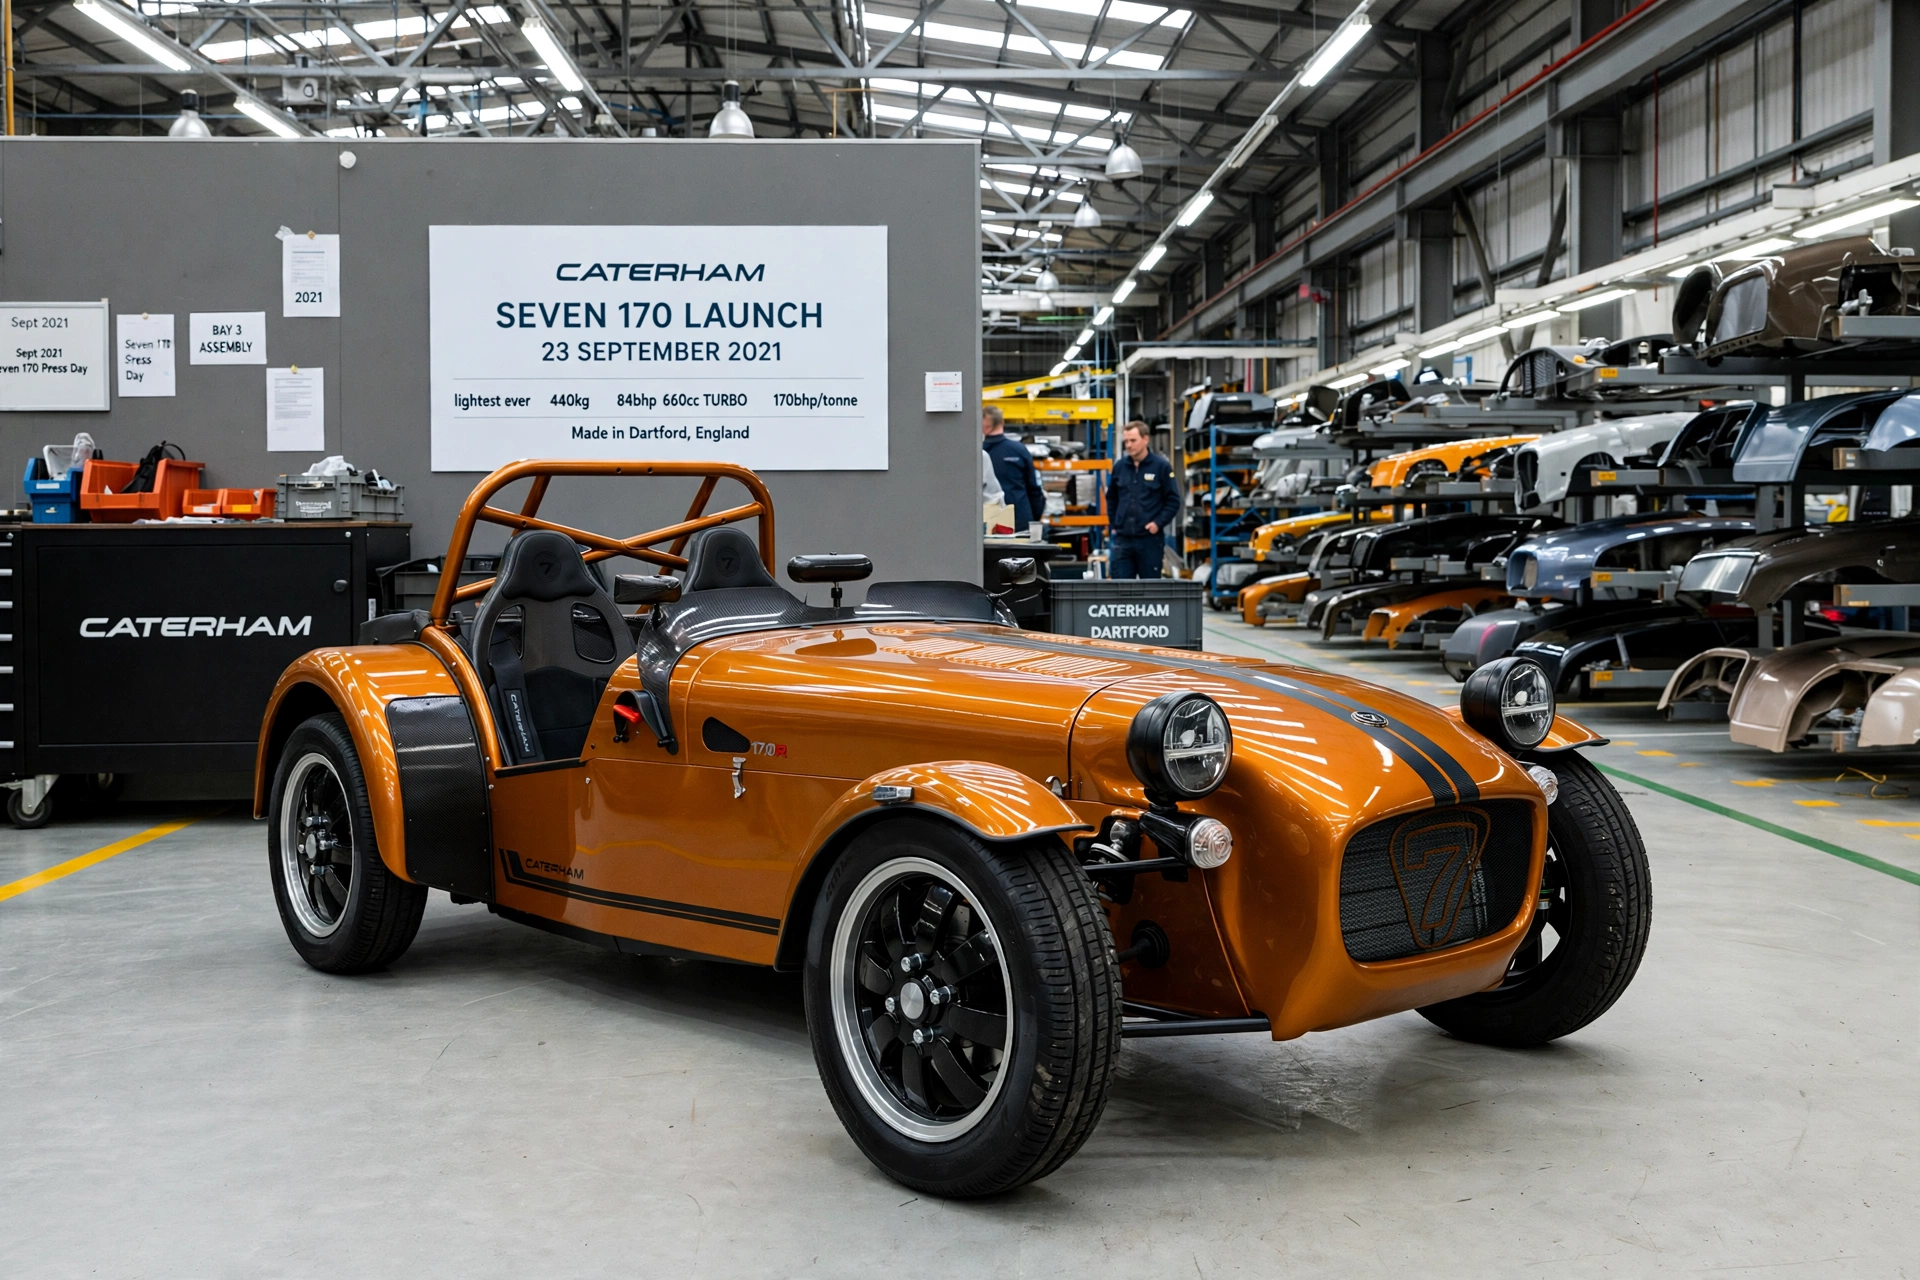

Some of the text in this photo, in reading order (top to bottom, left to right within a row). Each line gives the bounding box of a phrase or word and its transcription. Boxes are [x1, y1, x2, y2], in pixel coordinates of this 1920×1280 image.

[556, 262, 766, 282] CATERHAM
[294, 291, 323, 304] 2021
[496, 301, 822, 329] SEVEN 170 LAUNCH
[11, 316, 69, 331] Sept 2021
[212, 324, 242, 336] BAY 3
[125, 339, 154, 350] Seven
[199, 340, 253, 354] ASSEMBLY
[541, 341, 781, 362] 23 SEPTEMBER 2021
[15, 347, 63, 360] Sept 2021
[22, 362, 39, 374] 170
[41, 362, 68, 374] Press
[70, 362, 88, 376] Day
[126, 370, 145, 383] Day
[454, 392, 858, 411] lightest ever 440kg 84bhp 660cc TURBO 170bhp/tonne
[571, 424, 750, 443] Made in Dartford, England
[1087, 603, 1170, 618] CATERHAM
[79, 615, 312, 638] CATERHAM
[1090, 625, 1170, 639] DARTFORD
[525, 858, 584, 880] CATERHAM
